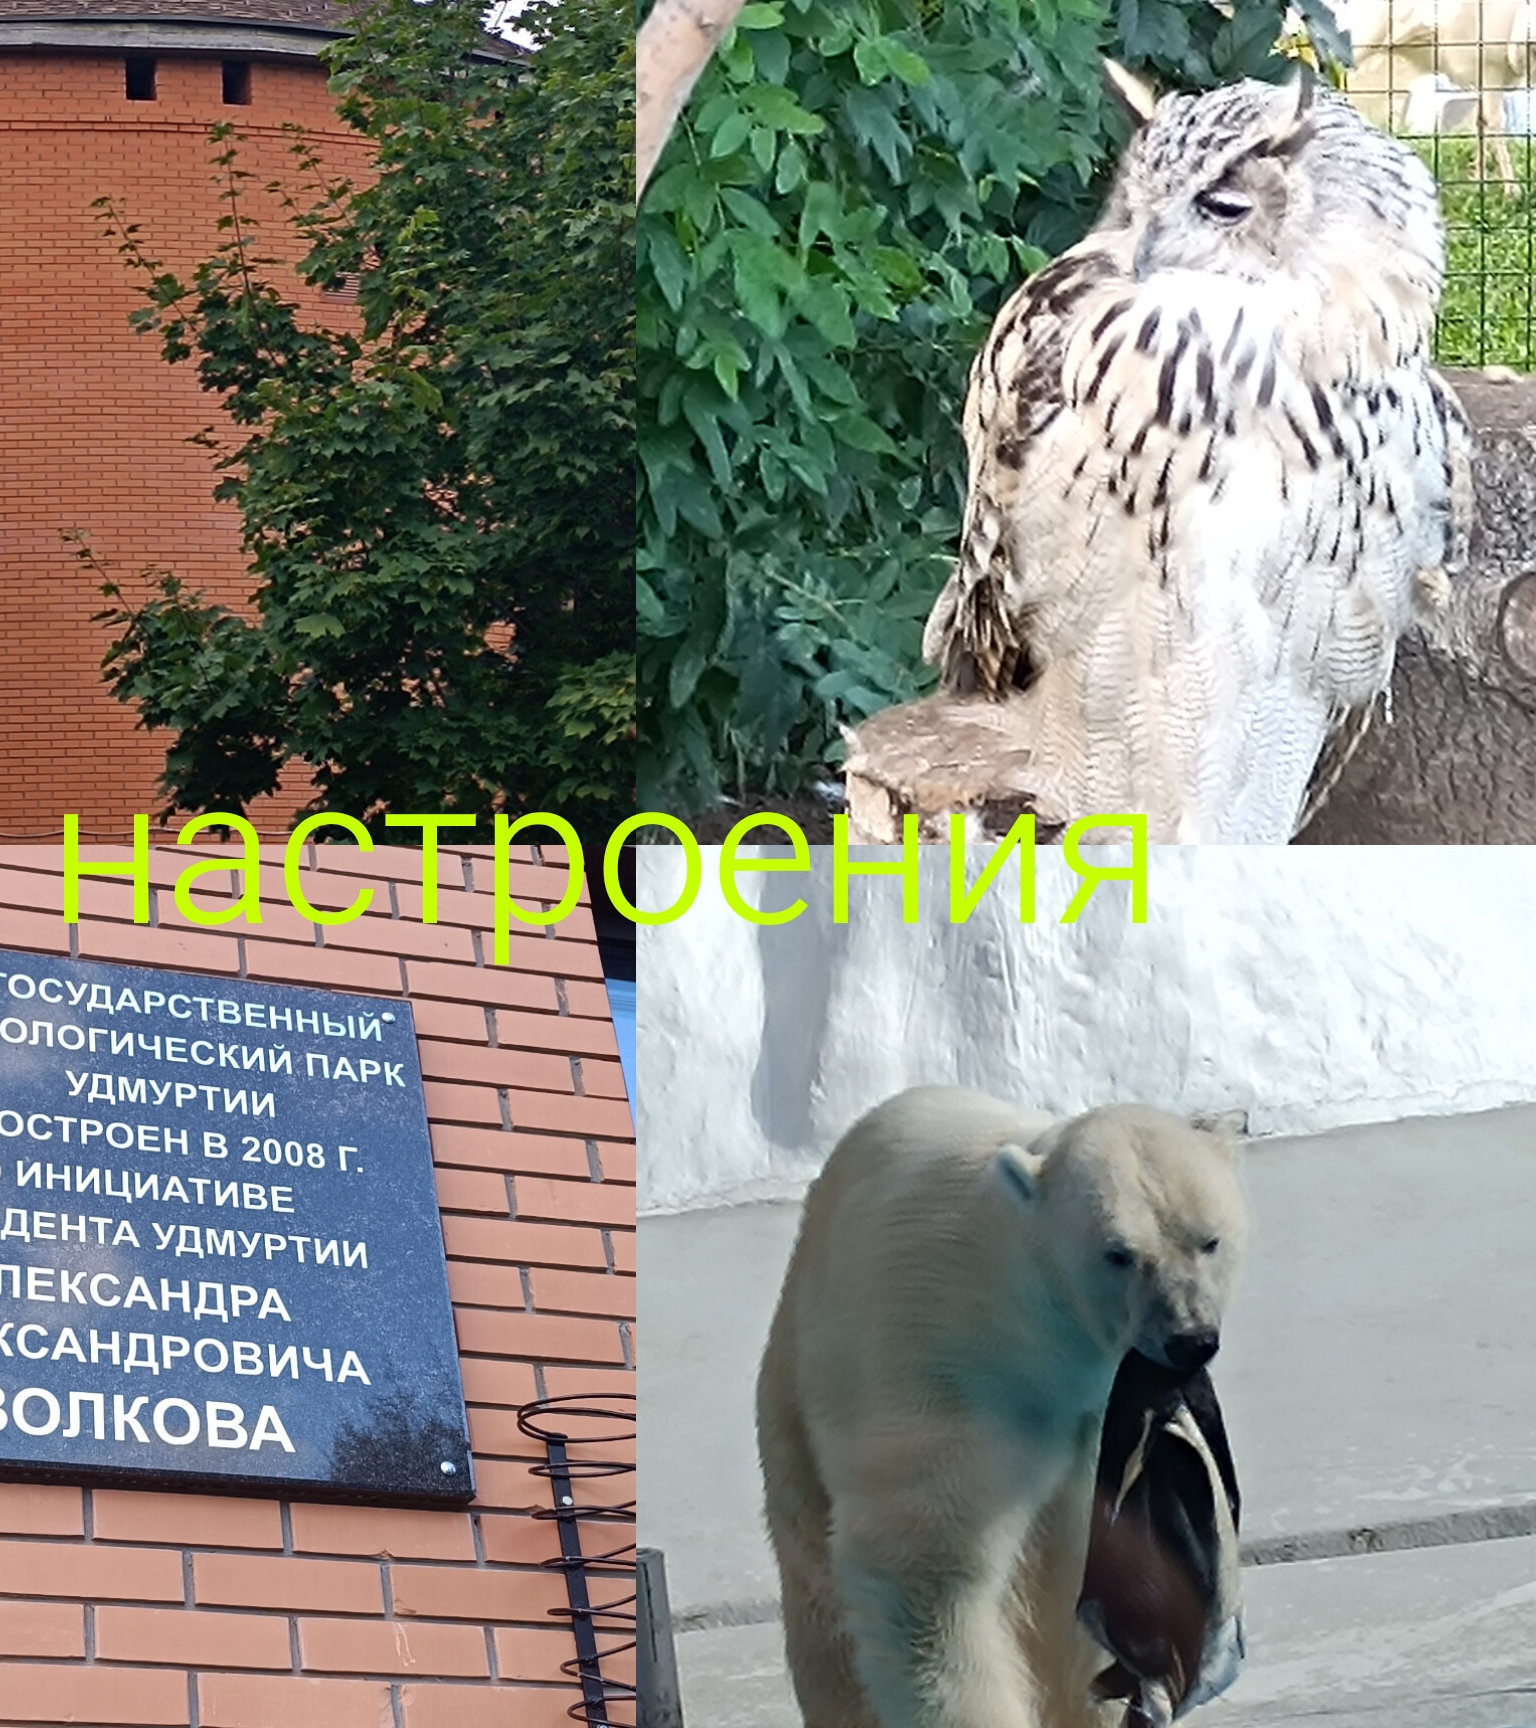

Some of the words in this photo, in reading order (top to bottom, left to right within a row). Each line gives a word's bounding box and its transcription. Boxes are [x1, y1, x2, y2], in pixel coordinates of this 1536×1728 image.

[65, 1069, 276, 1118] УДМУРТИИ
[305, 1052, 406, 1088] ПАРК
[203, 1131, 229, 1159] В
[241, 1136, 326, 1169] 2008
[338, 1145, 365, 1173] Г.
[16, 1160, 295, 1214] ИНИЦИАТИВЕ
[151, 1222, 368, 1269] УДМУРТИИ
